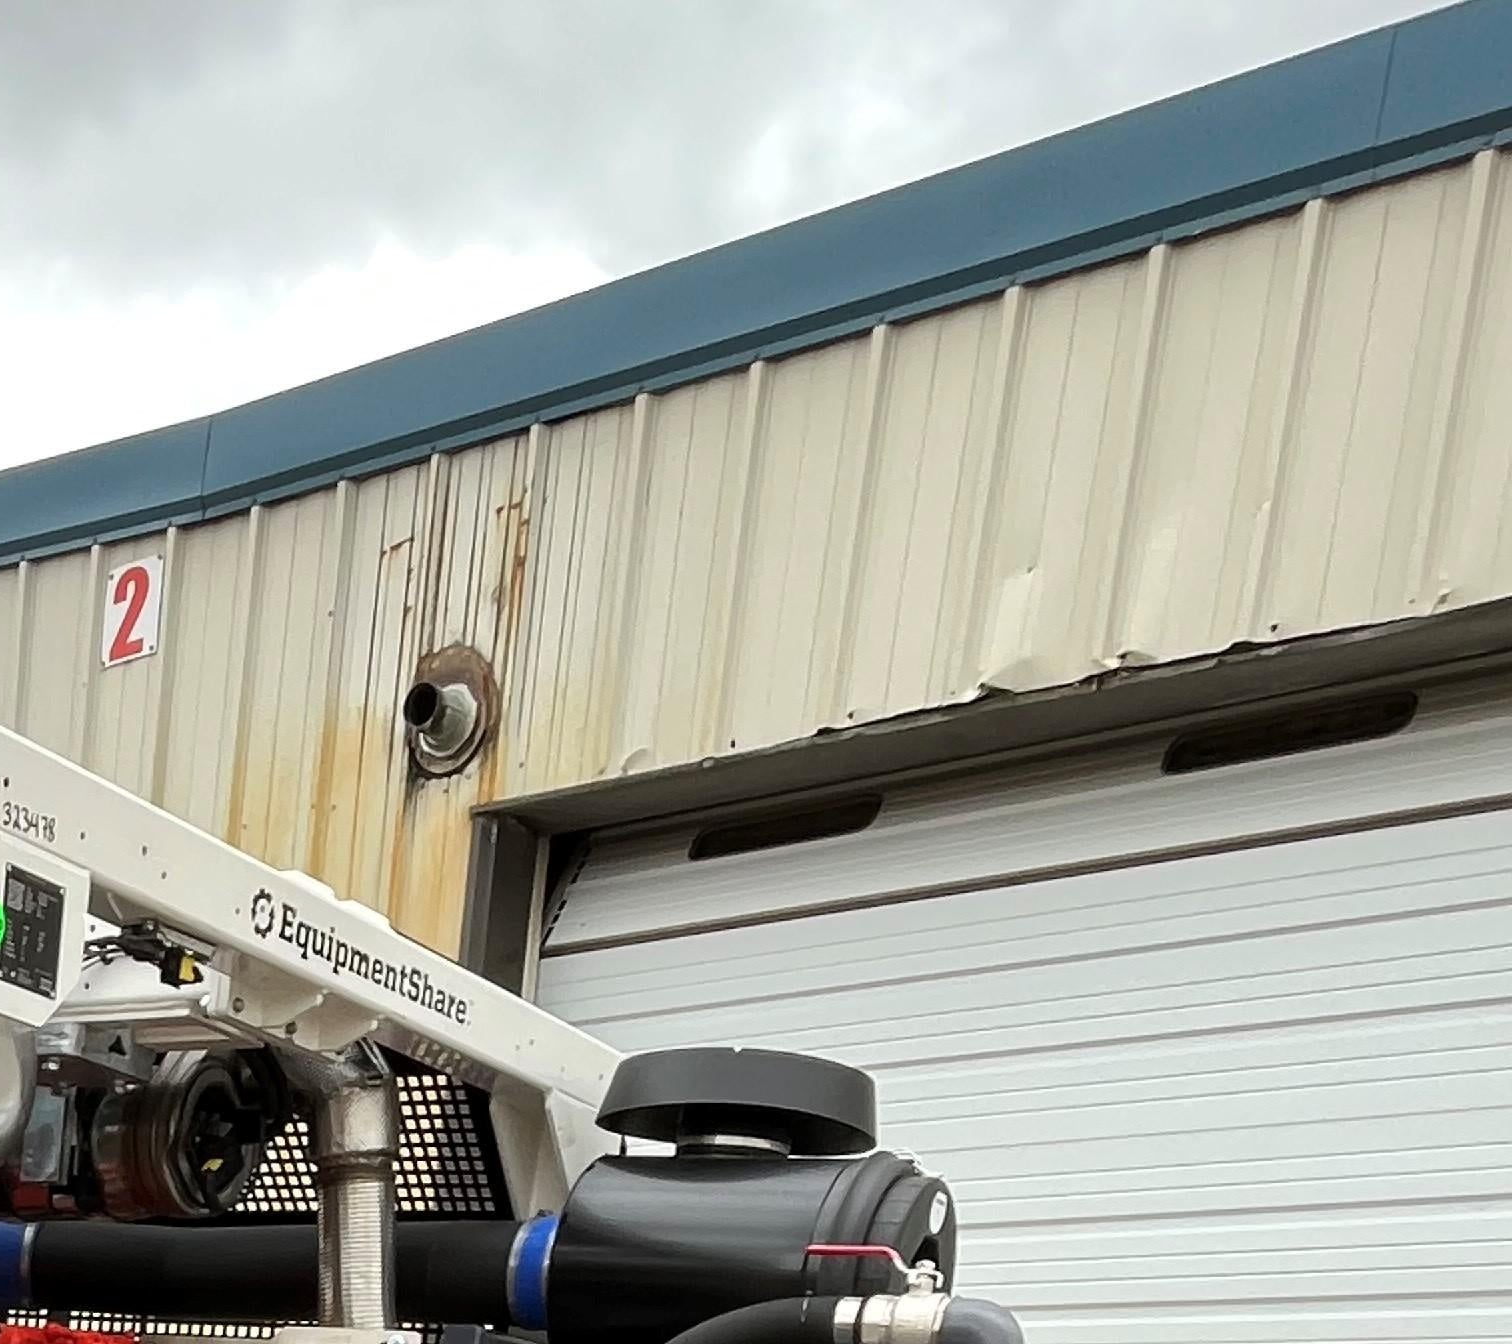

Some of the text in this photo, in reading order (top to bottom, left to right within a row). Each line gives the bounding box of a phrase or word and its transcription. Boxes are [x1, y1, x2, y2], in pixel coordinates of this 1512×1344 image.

[109, 566, 149, 661] 2
[3, 801, 56, 842] 323478
[279, 902, 470, 1025] EquipmentShare
